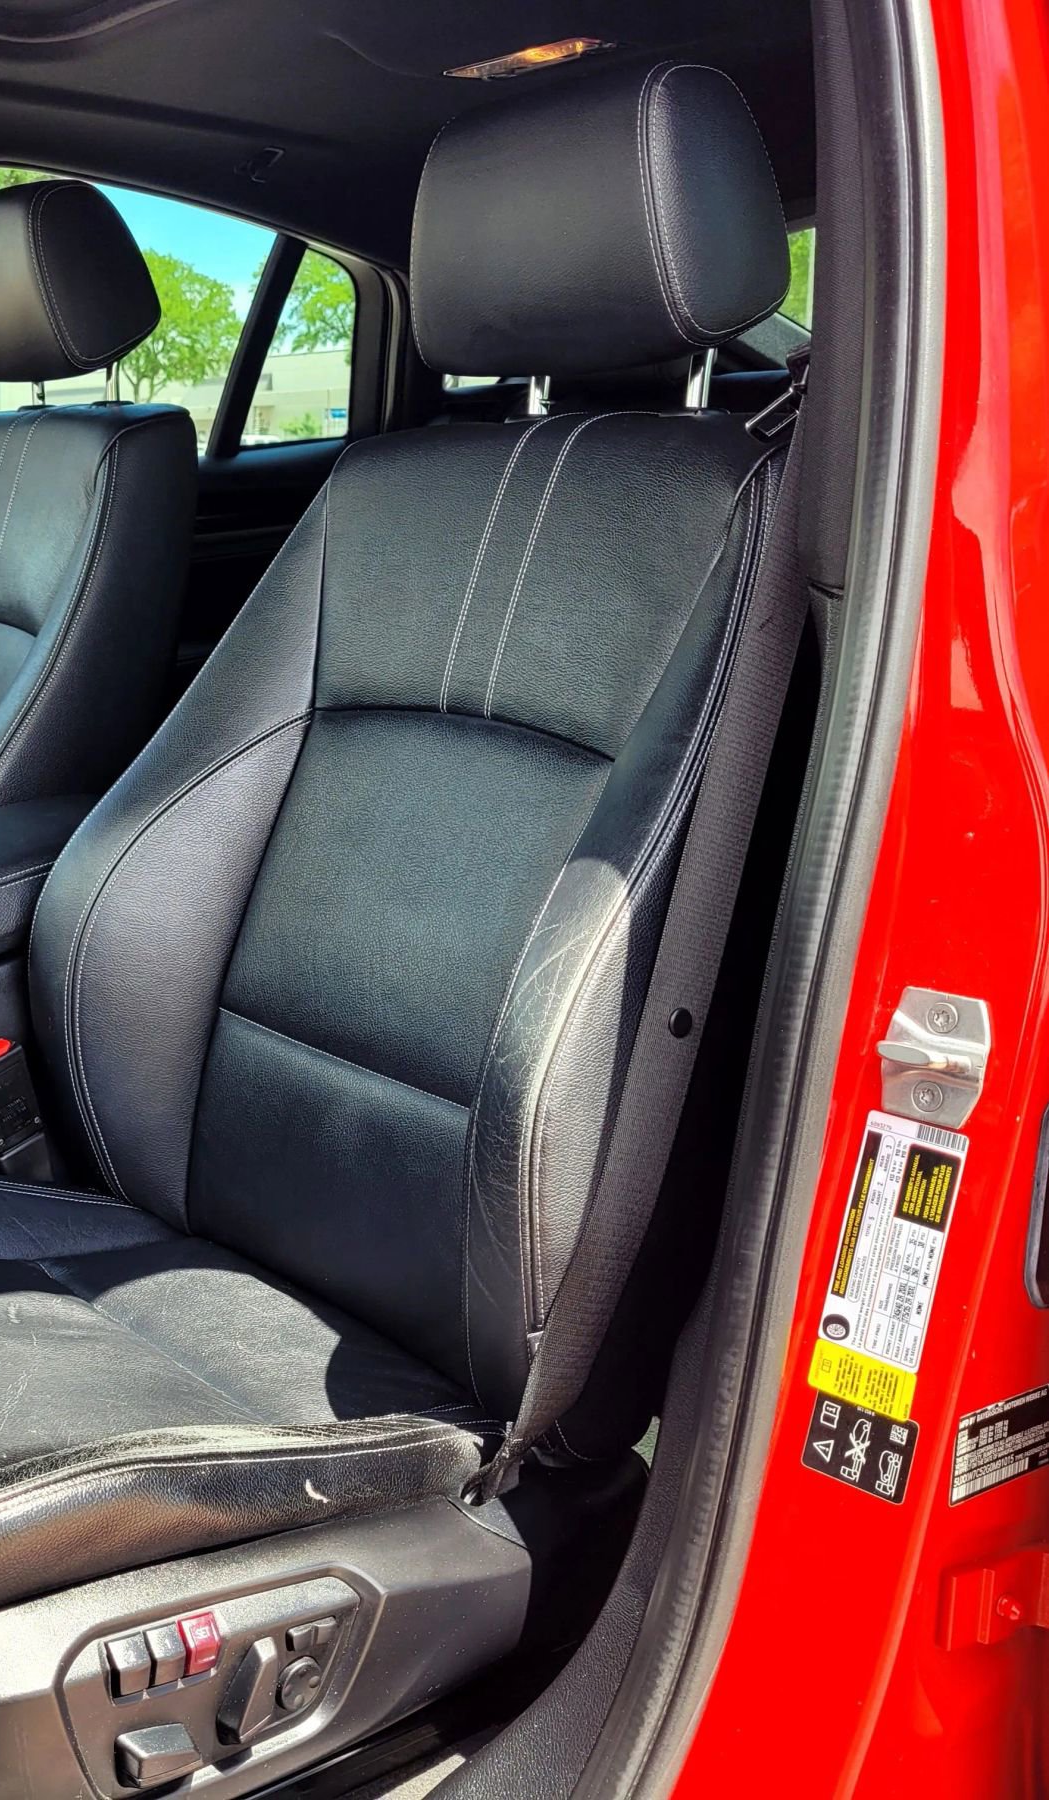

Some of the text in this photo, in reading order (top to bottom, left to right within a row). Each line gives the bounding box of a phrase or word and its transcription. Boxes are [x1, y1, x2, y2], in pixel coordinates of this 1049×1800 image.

[910, 1154, 920, 1176] MANUAL
[938, 1163, 946, 1178] PLUS
[910, 1169, 923, 1202] ADDITIONAL
[914, 1178, 927, 1216] INFORMATION
[922, 1165, 939, 1218] VOIR LE MANUEL DE
[934, 1178, 943, 1194] POUR
[934, 1165, 952, 1222] DE RENSEIGNEMENTS
[838, 1244, 848, 1267] LOADING
[844, 1208, 856, 1245] INFORMATION
[1040, 1388, 1048, 1398] AG
[193, 1626, 211, 1639] SET
